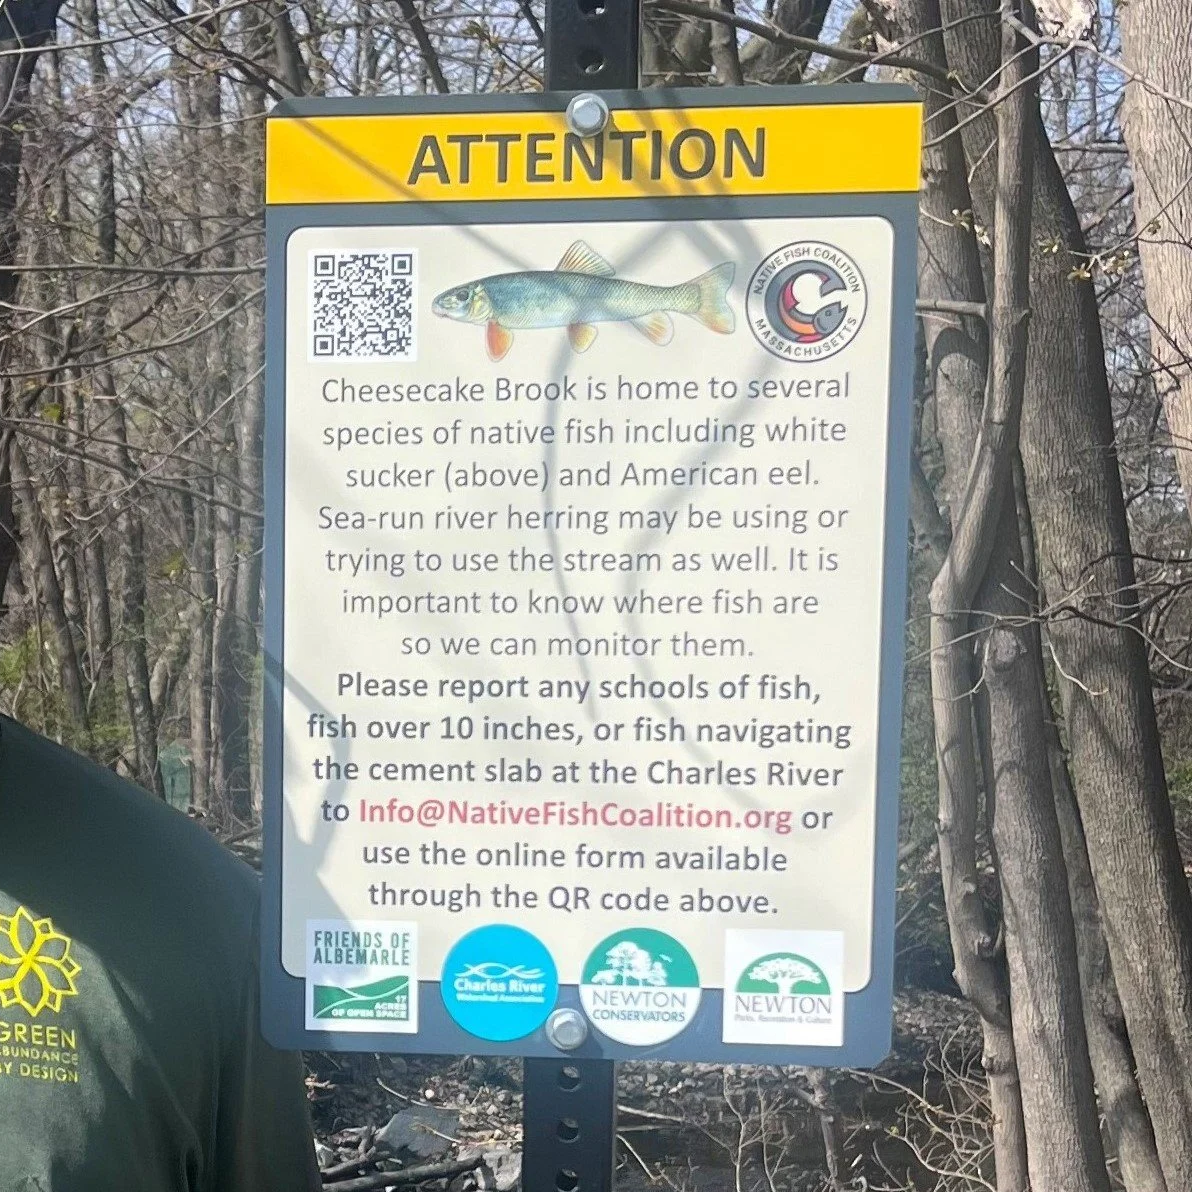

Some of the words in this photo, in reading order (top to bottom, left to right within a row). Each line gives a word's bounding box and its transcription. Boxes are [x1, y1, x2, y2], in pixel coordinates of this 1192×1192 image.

[408, 128, 764, 184] ATTENTION
[753, 256, 784, 294] NATIVE
[783, 246, 811, 262] FISH
[813, 247, 861, 293] COALITION
[755, 317, 857, 357] MASSACHUSETTS
[321, 376, 486, 404] Cheesecake
[494, 375, 578, 402] Brook
[586, 375, 608, 402] is
[616, 374, 700, 401] home
[708, 376, 739, 400] to
[747, 372, 851, 400] several
[321, 419, 424, 454] species
[432, 418, 464, 446] of
[469, 418, 555, 445] native
[563, 417, 615, 445] fish
[624, 416, 756, 452] including
[764, 415, 847, 443] white
[345, 461, 436, 489] sucker
[443, 461, 550, 496] (above)
[557, 460, 611, 488] and
[619, 460, 758, 487] American
[767, 459, 820, 486] eel.
[317, 503, 425, 531] Sea-run
[434, 503, 499, 530] river
[507, 502, 610, 537] herring
[618, 509, 679, 537] may
[687, 502, 722, 529] be
[731, 502, 809, 537] using
[817, 508, 849, 528] or
[325, 545, 406, 580] trying
[413, 548, 443, 572] to
[452, 552, 499, 572] use
[507, 545, 555, 572] the
[562, 548, 662, 572] stream
[671, 552, 702, 572] as
[710, 545, 779, 572] well.
[788, 545, 809, 572] It
[817, 545, 840, 572] is
[342, 588, 482, 622] important
[490, 590, 519, 614] to
[527, 588, 605, 614] know
[613, 588, 704, 615] where
[711, 588, 763, 615] fish
[772, 595, 820, 615] are
[400, 636, 432, 656] so
[439, 636, 481, 656] we
[488, 636, 538, 656] can
[546, 630, 663, 657] monitor
[669, 630, 755, 657] them.
[336, 670, 429, 698] Please
[437, 674, 531, 707] report
[537, 679, 592, 707] any
[598, 673, 710, 700] schools
[718, 674, 751, 701] of
[756, 674, 822, 705] fish,
[306, 712, 358, 739] fish
[365, 719, 431, 740] over
[439, 715, 474, 741] 10
[482, 714, 584, 746] inches,
[593, 722, 627, 742] or
[632, 715, 687, 743] fish
[695, 717, 852, 753] navigating
[311, 753, 360, 780] the
[367, 756, 477, 782] cement
[483, 755, 544, 783] slab
[550, 759, 583, 784] at
[589, 757, 639, 784] the
[646, 758, 757, 786] Charles
[766, 759, 845, 787] River
[321, 797, 351, 822] to
[358, 795, 793, 838] Info@NativeFishCoalition.org
[800, 810, 834, 831] or
[361, 843, 410, 864] use
[418, 838, 467, 865] the
[475, 839, 567, 867] online
[574, 841, 646, 869] form
[654, 842, 788, 872] available
[367, 879, 482, 916] through
[489, 881, 539, 909] the
[547, 882, 591, 915] QR
[599, 884, 670, 912] code
[678, 885, 780, 914] above.
[314, 931, 383, 948] FRIENDS
[390, 932, 410, 949] OF
[314, 948, 410, 966] ALBEMARLE
[454, 978, 506, 992] Charles
[509, 980, 546, 993] River
[592, 990, 687, 1008] NEWTON
[592, 1009, 686, 1022] CONSERVATORS
[734, 994, 832, 1014] NEWTON
[19, 1062, 79, 1083] DESIGN
